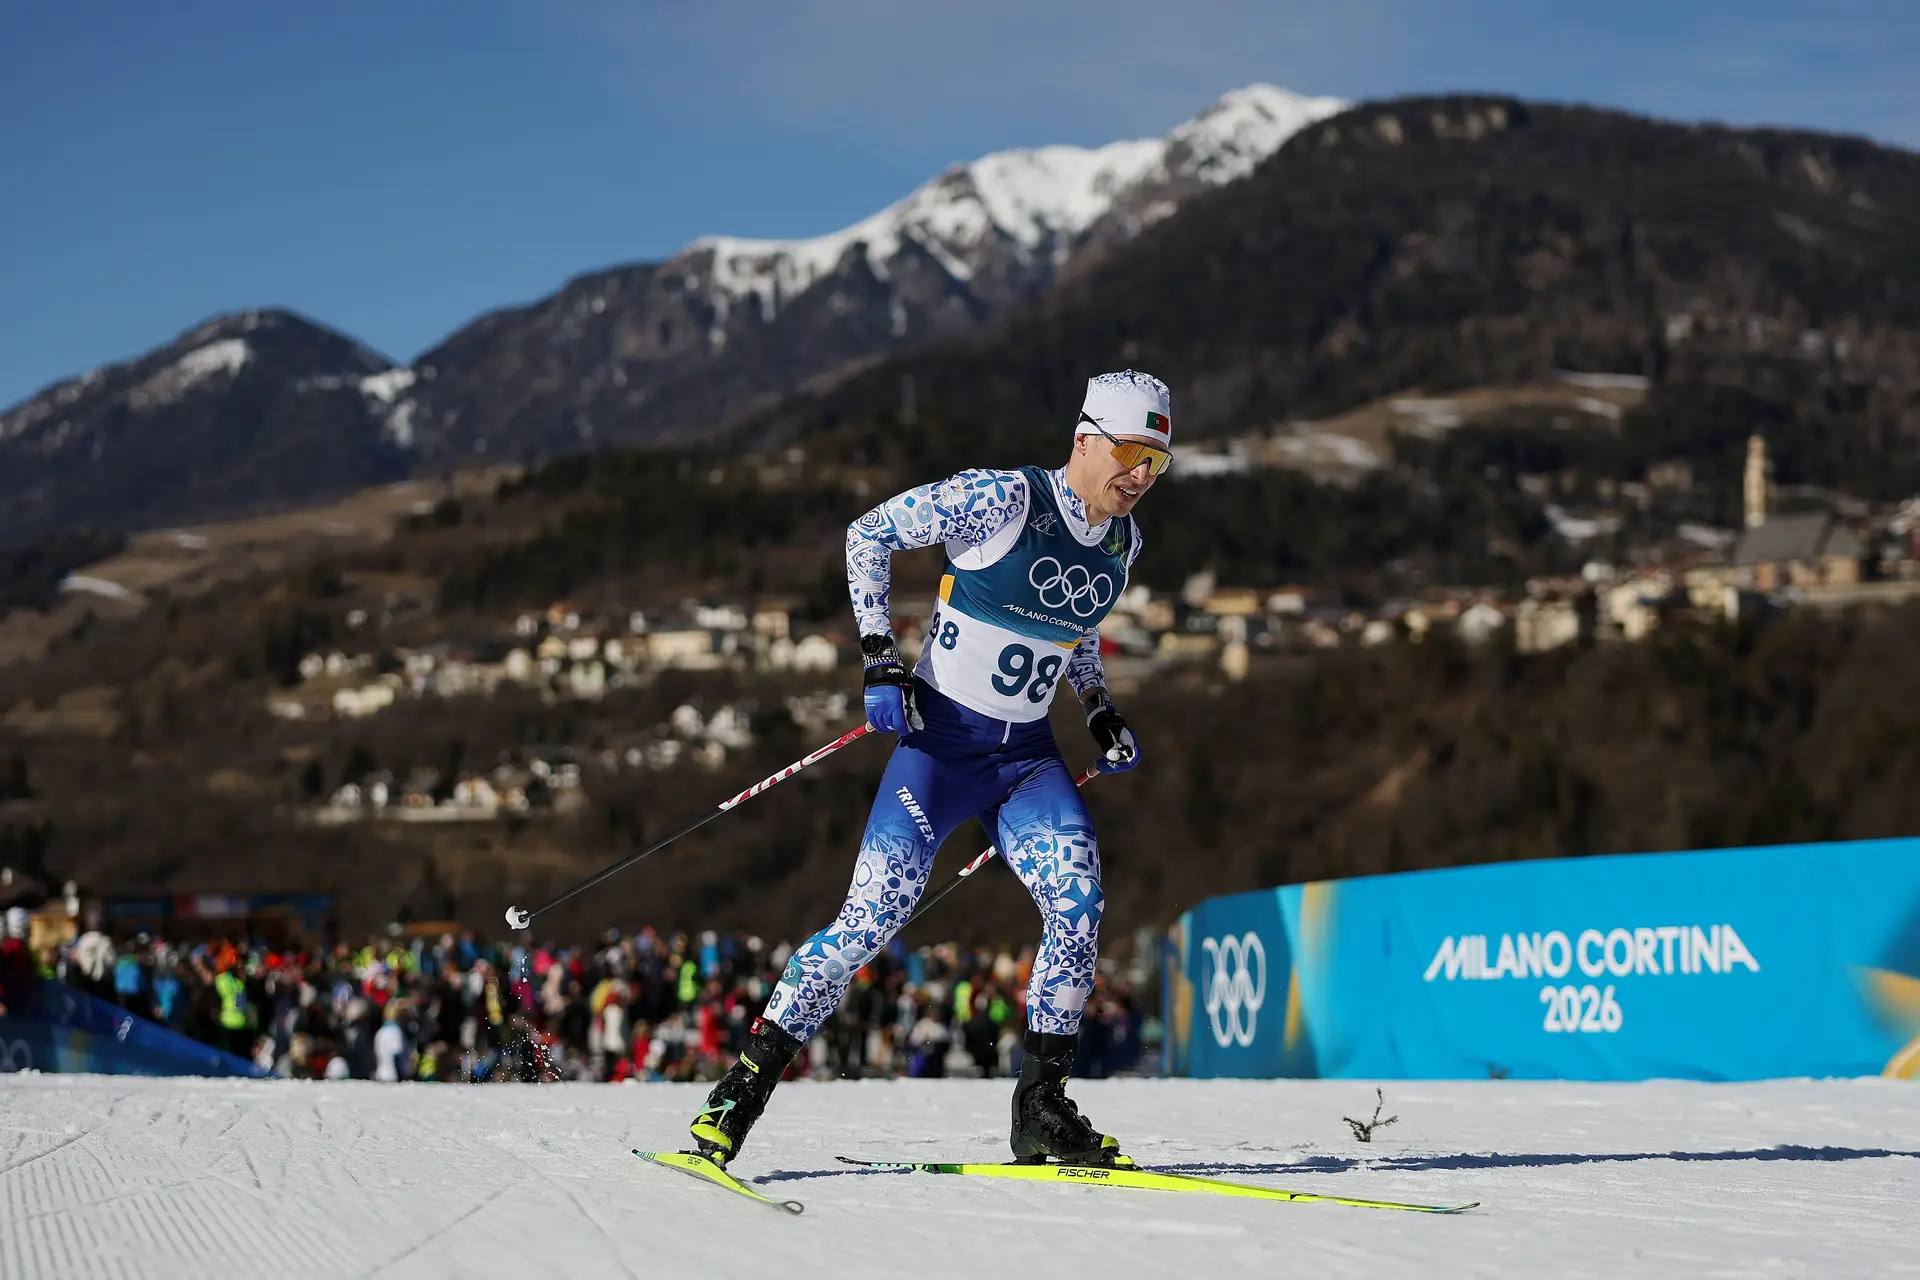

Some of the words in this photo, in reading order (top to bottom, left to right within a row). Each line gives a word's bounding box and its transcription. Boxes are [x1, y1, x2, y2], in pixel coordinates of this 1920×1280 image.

[1002, 604, 1048, 622] MILANO
[1049, 617, 1084, 634] CORTINA
[991, 643, 1063, 704] 98
[895, 785, 936, 843] TRIMTEX
[1424, 930, 1573, 982] MILANO
[1576, 923, 1761, 976] CORTINA
[1539, 984, 1623, 1033] 2026
[1057, 1168, 1110, 1180] FISCHER
